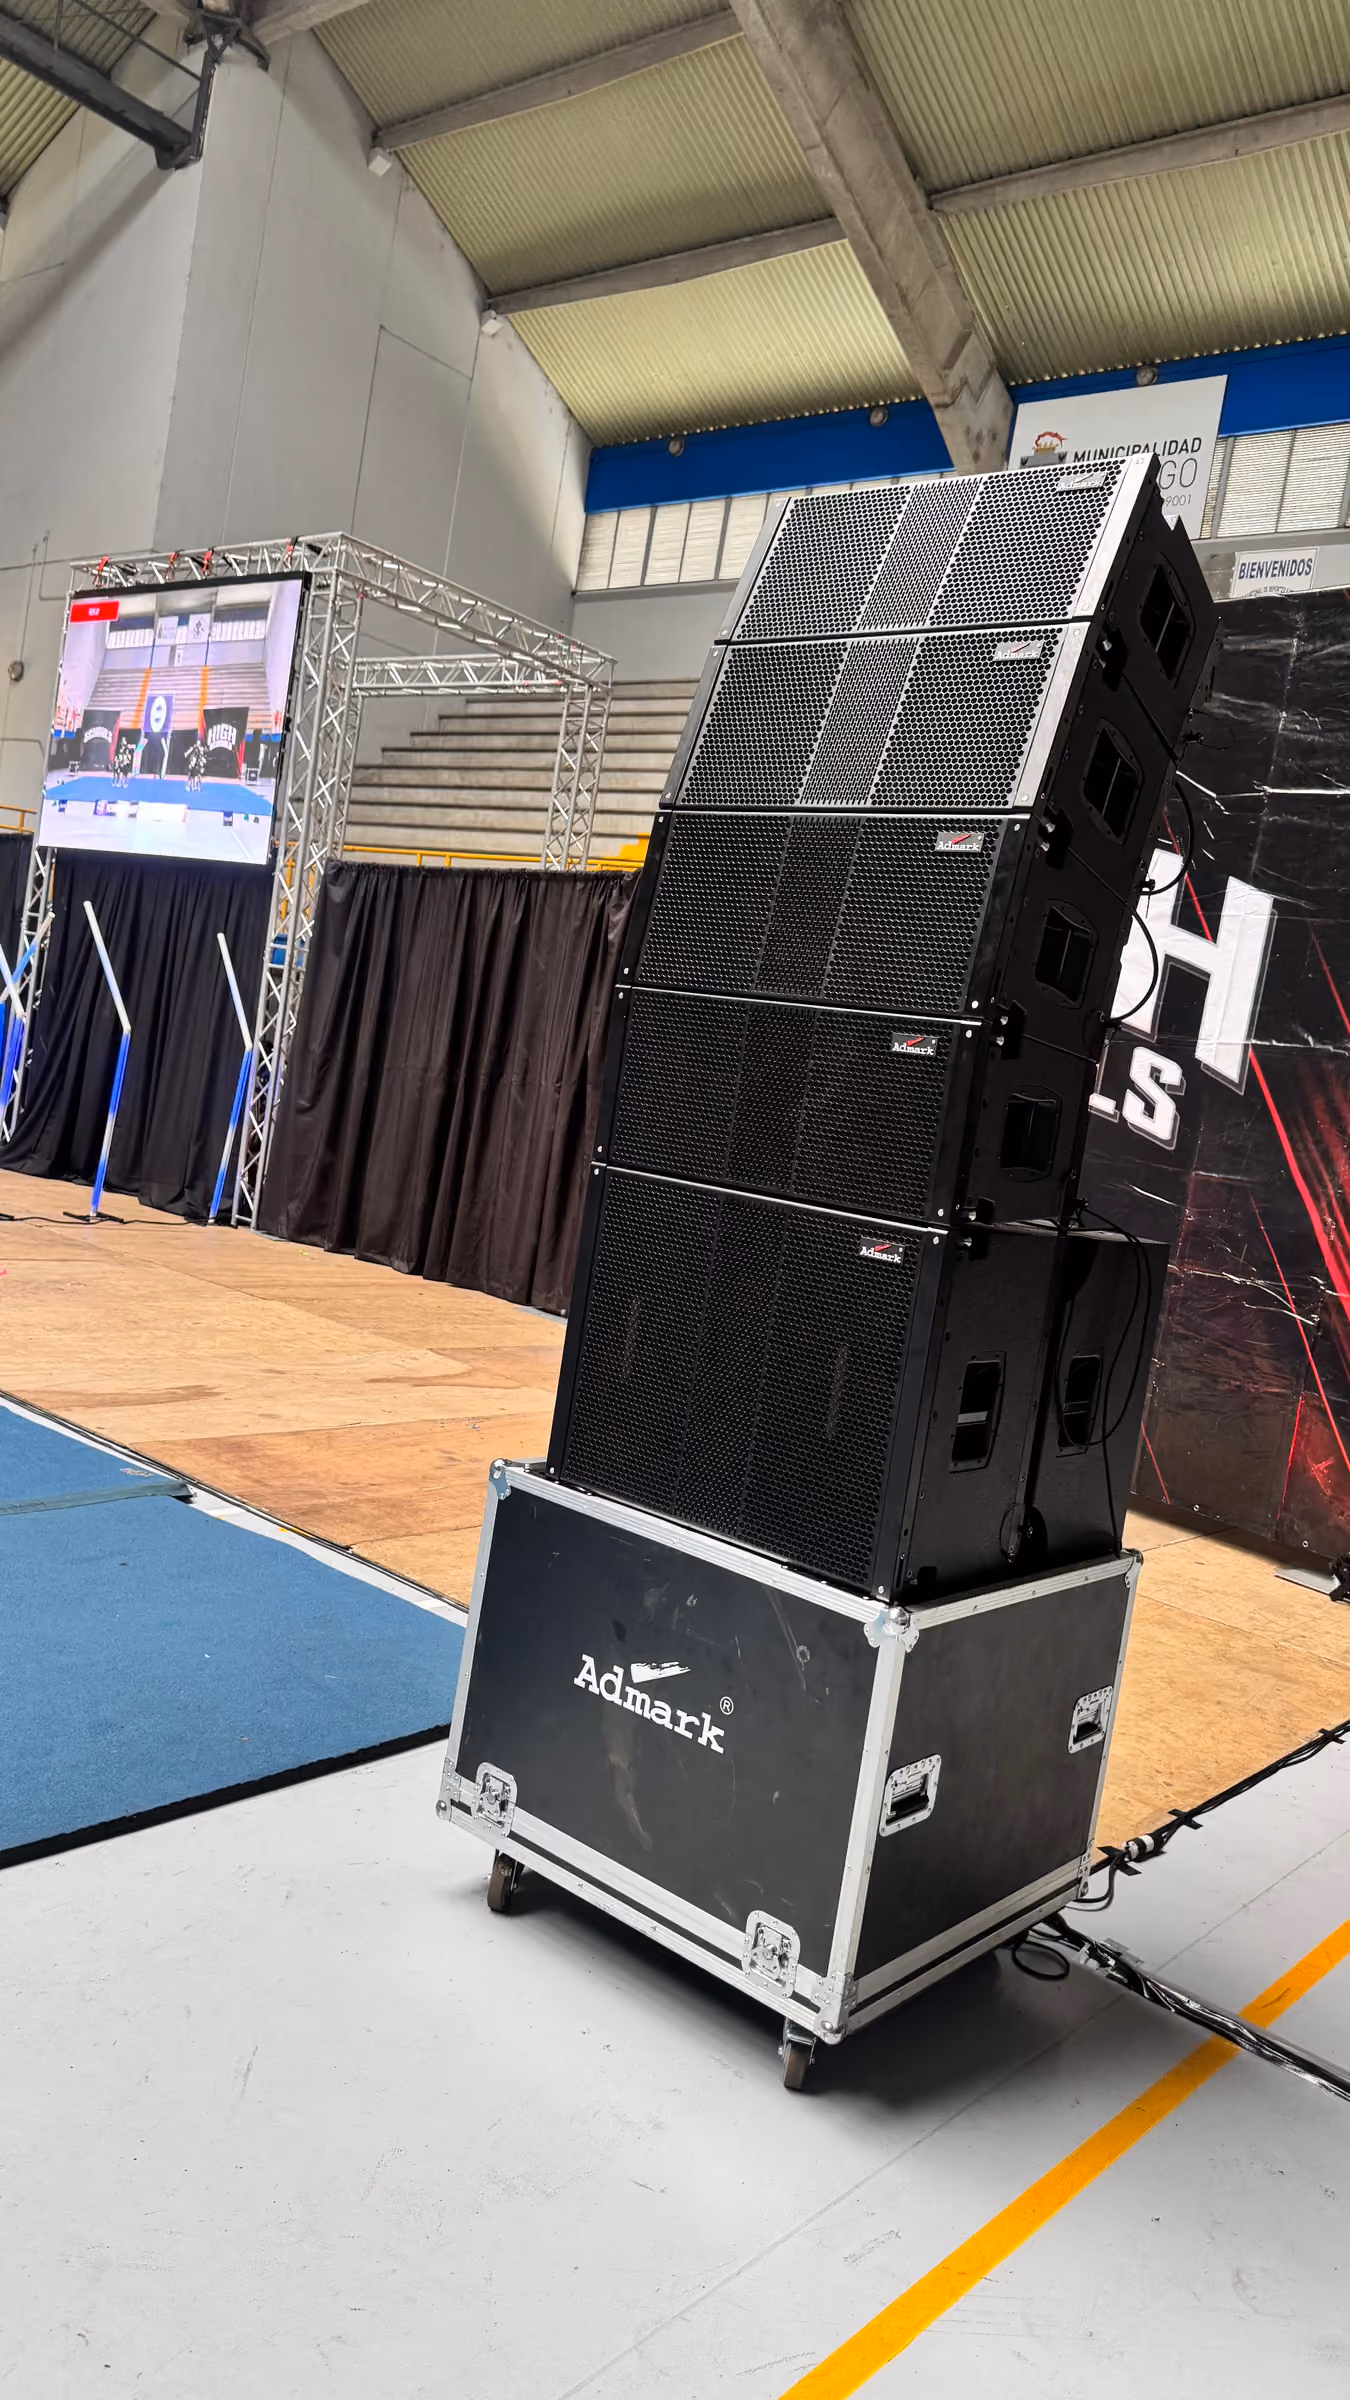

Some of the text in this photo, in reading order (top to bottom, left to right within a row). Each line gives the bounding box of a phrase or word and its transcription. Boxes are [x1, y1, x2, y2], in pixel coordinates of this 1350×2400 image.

[1073, 437, 1202, 463] MUNICIPALIDAD
[1165, 494, 1192, 507] 9001
[1238, 558, 1313, 579] BIENVENIDOS
[995, 649, 1040, 660] Admark
[936, 841, 980, 852] Admark
[892, 1041, 935, 1056] Admark
[859, 1246, 902, 1264] Admark
[574, 1654, 725, 1754] Admark
